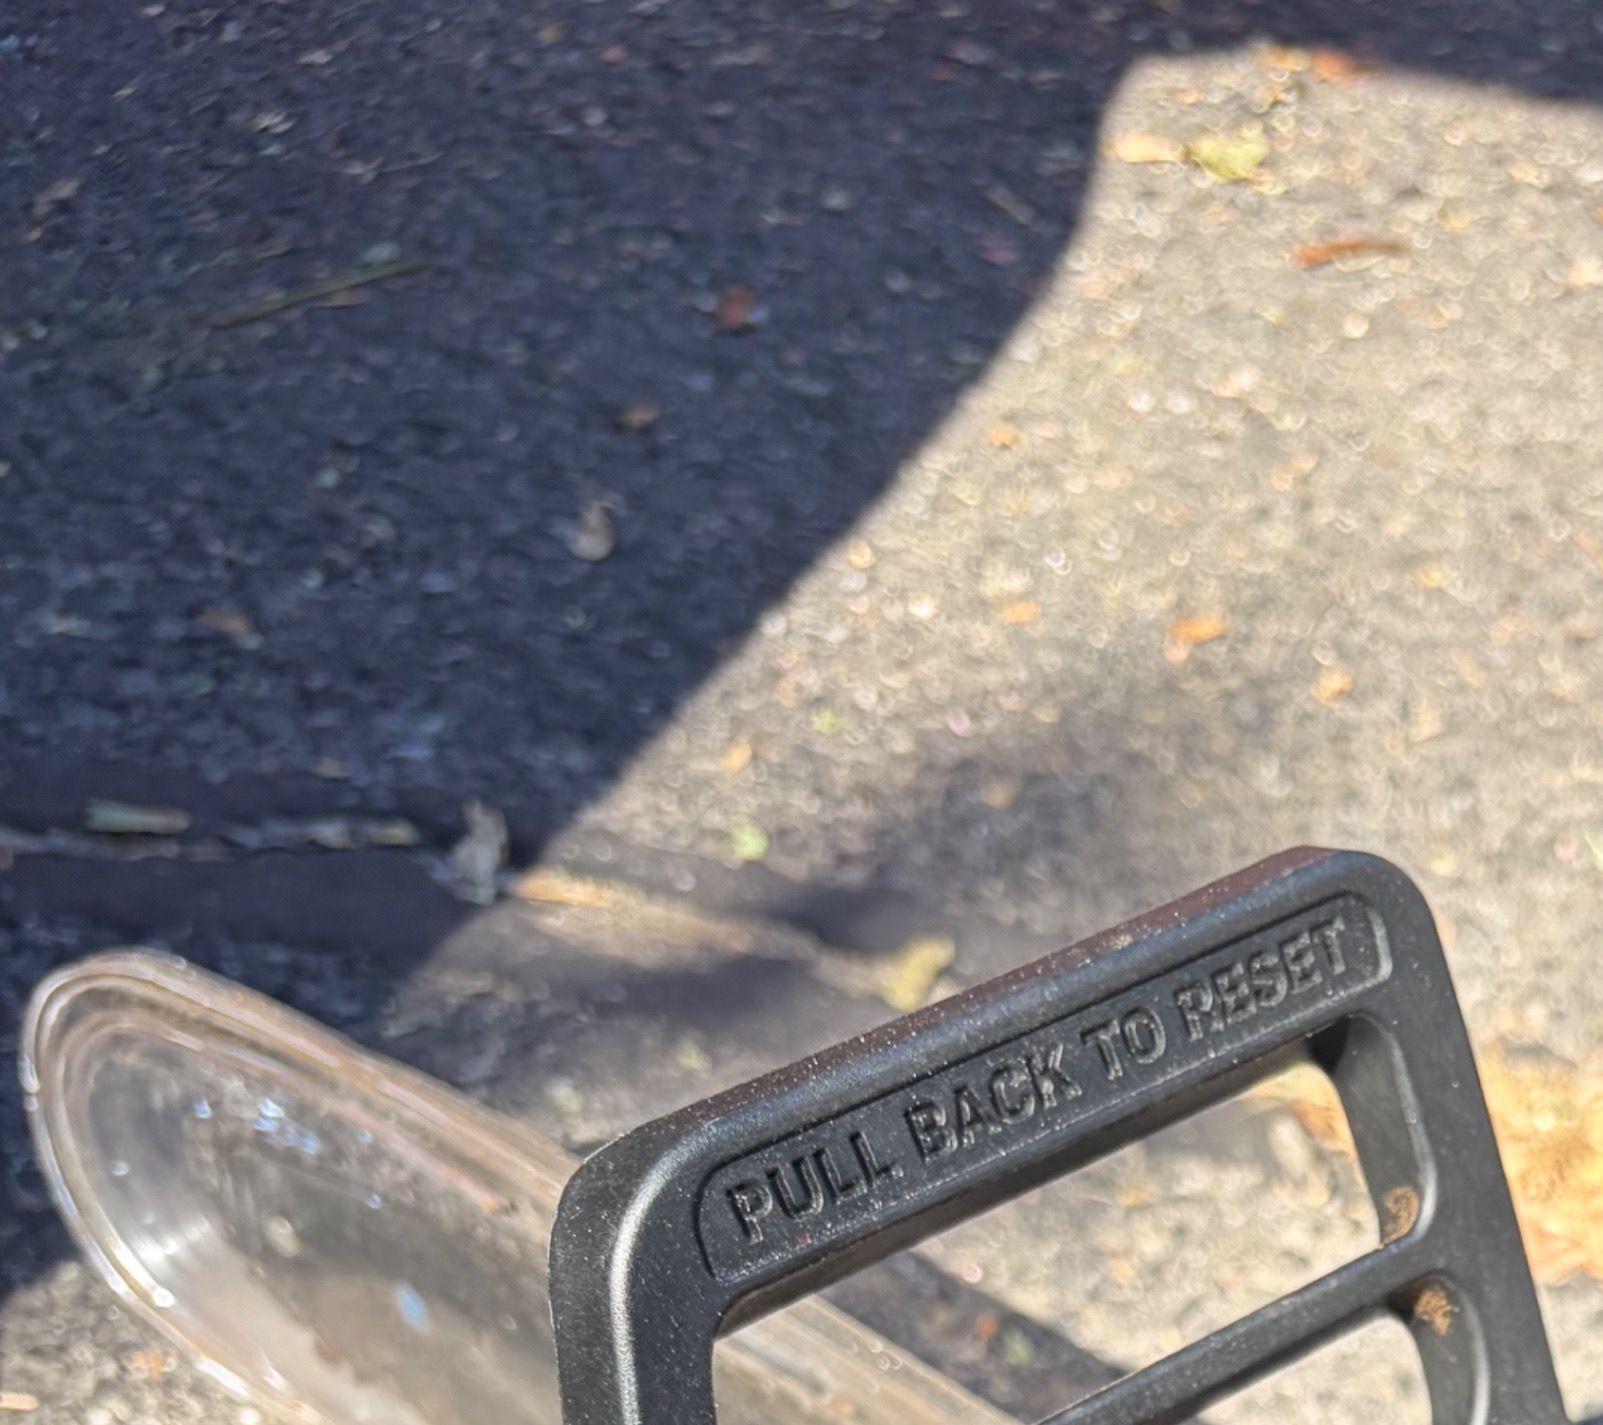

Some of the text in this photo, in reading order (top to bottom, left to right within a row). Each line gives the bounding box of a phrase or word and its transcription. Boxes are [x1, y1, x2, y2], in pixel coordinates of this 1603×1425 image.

[724, 917, 1346, 1245] PULL BACK TO RESET
